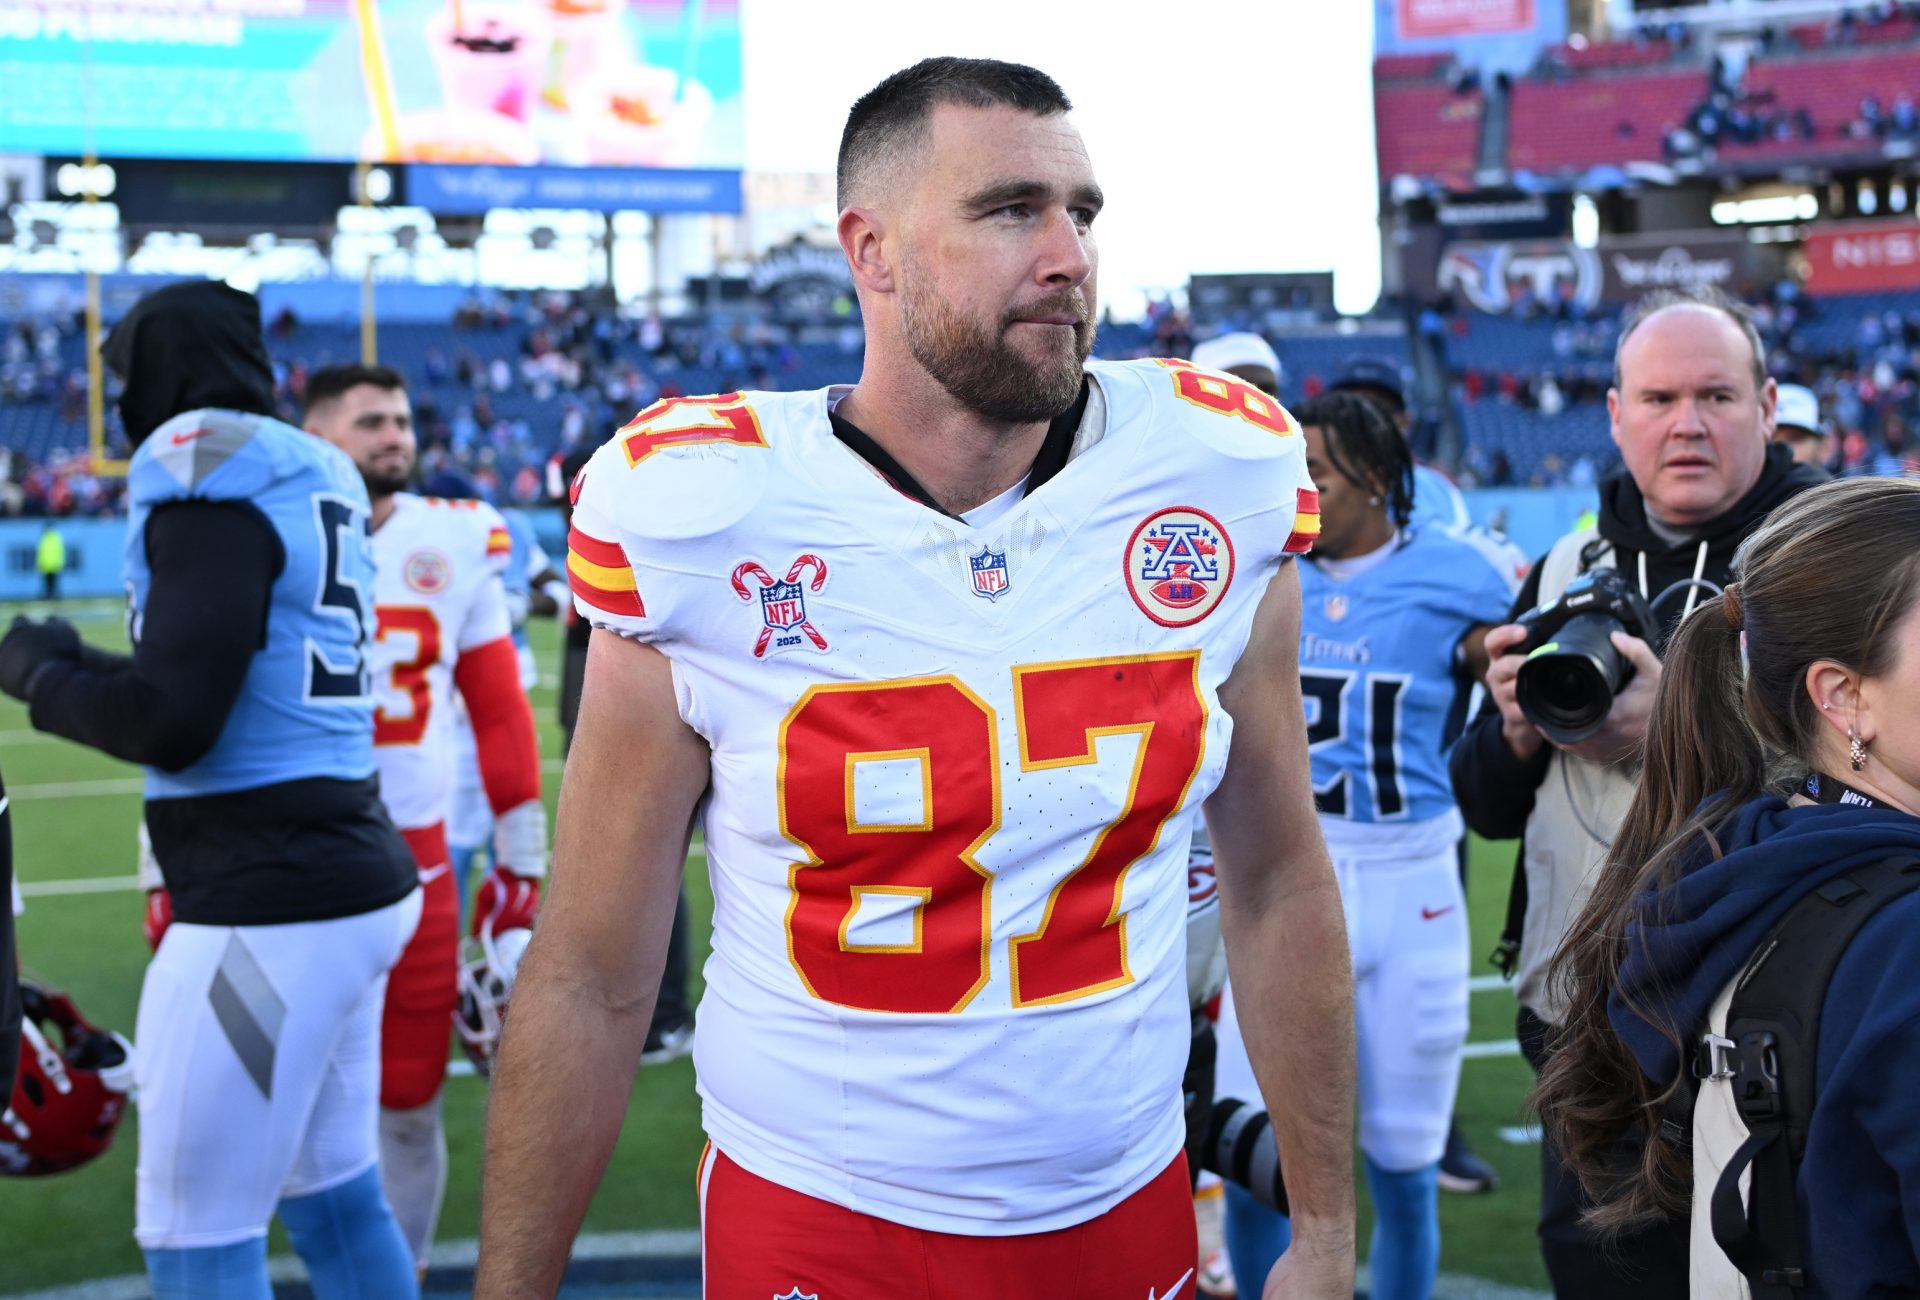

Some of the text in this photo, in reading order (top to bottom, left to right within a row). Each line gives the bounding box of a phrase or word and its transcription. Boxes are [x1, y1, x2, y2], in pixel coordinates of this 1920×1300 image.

[976, 569, 1006, 592] NFL
[1168, 585, 1193, 599] LH
[766, 600, 802, 626] NFL
[776, 635, 802, 648] 2025
[776, 648, 1209, 1014] 87
